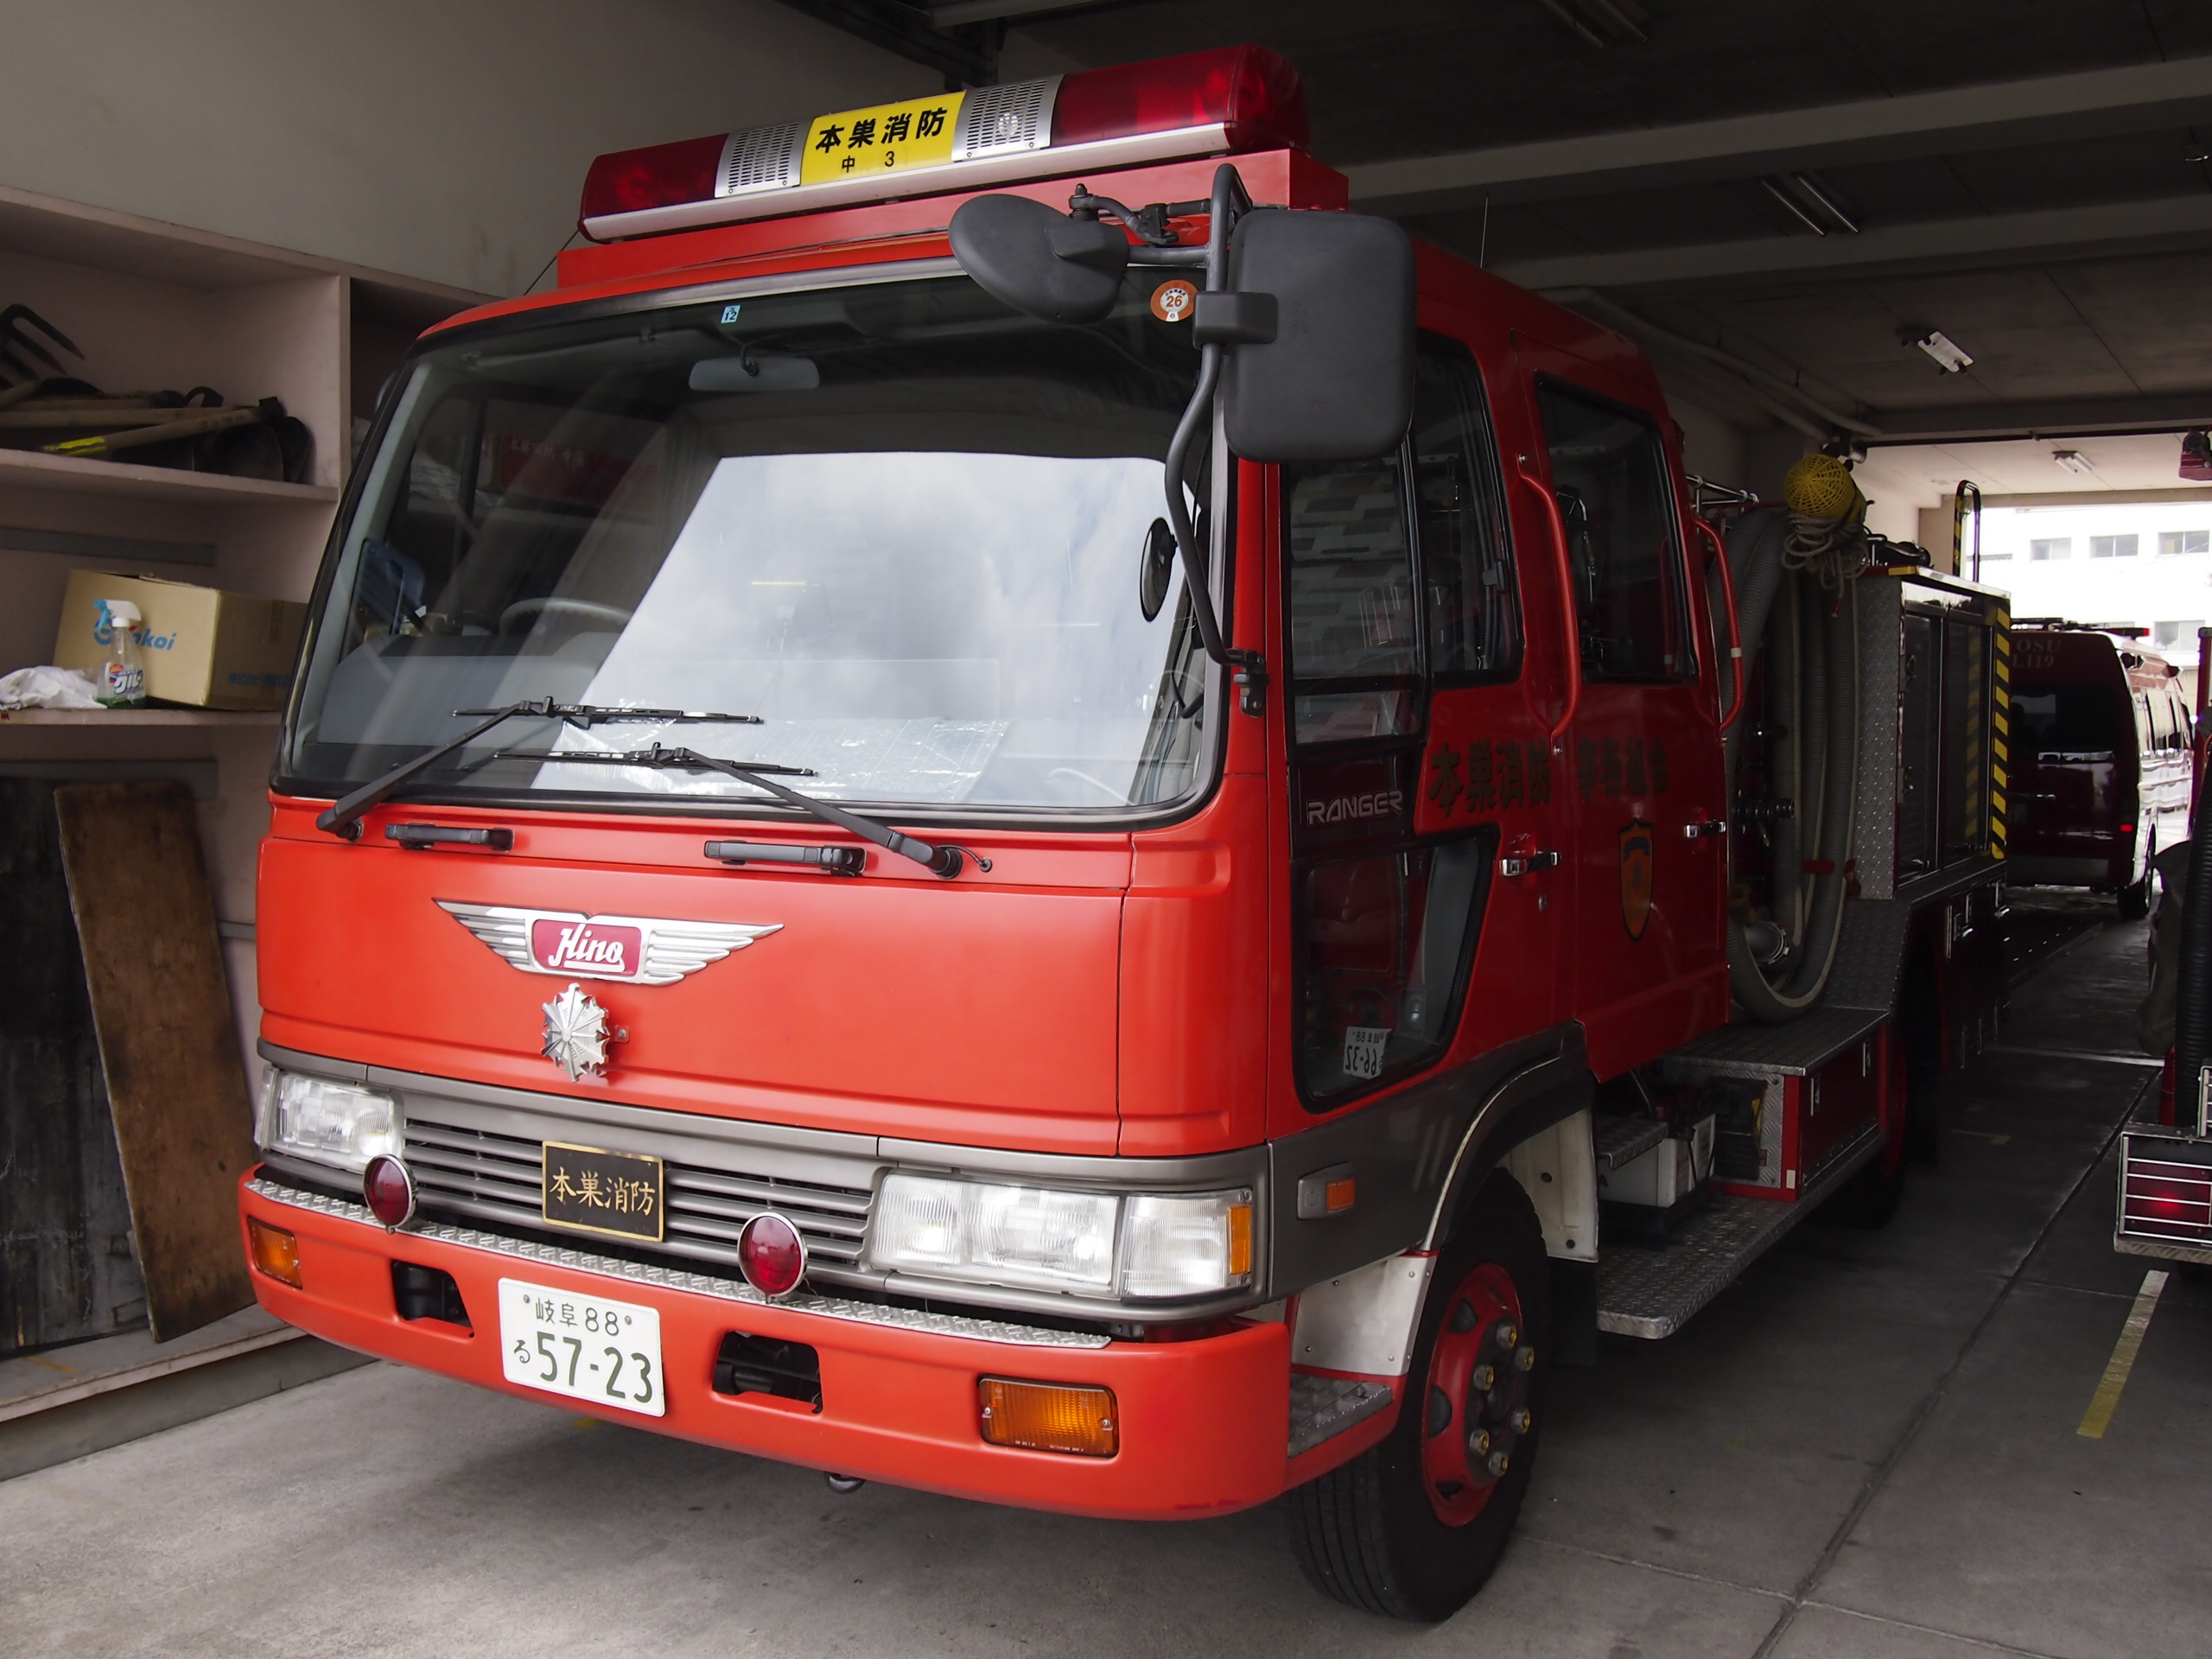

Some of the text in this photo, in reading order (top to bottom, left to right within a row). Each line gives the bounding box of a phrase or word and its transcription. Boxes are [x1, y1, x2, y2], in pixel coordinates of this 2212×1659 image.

[815, 106, 948, 154] 本巣消防
[841, 150, 895, 173] 中 3
[724, 311, 737, 321] 12
[1166, 295, 1183, 308] 26
[2012, 638, 2062, 653] OSU
[1306, 790, 1403, 825] RANGER
[548, 923, 625, 972] Hino
[550, 1166, 656, 1216] 本巣消防
[513, 1331, 653, 1403] る 57-23
